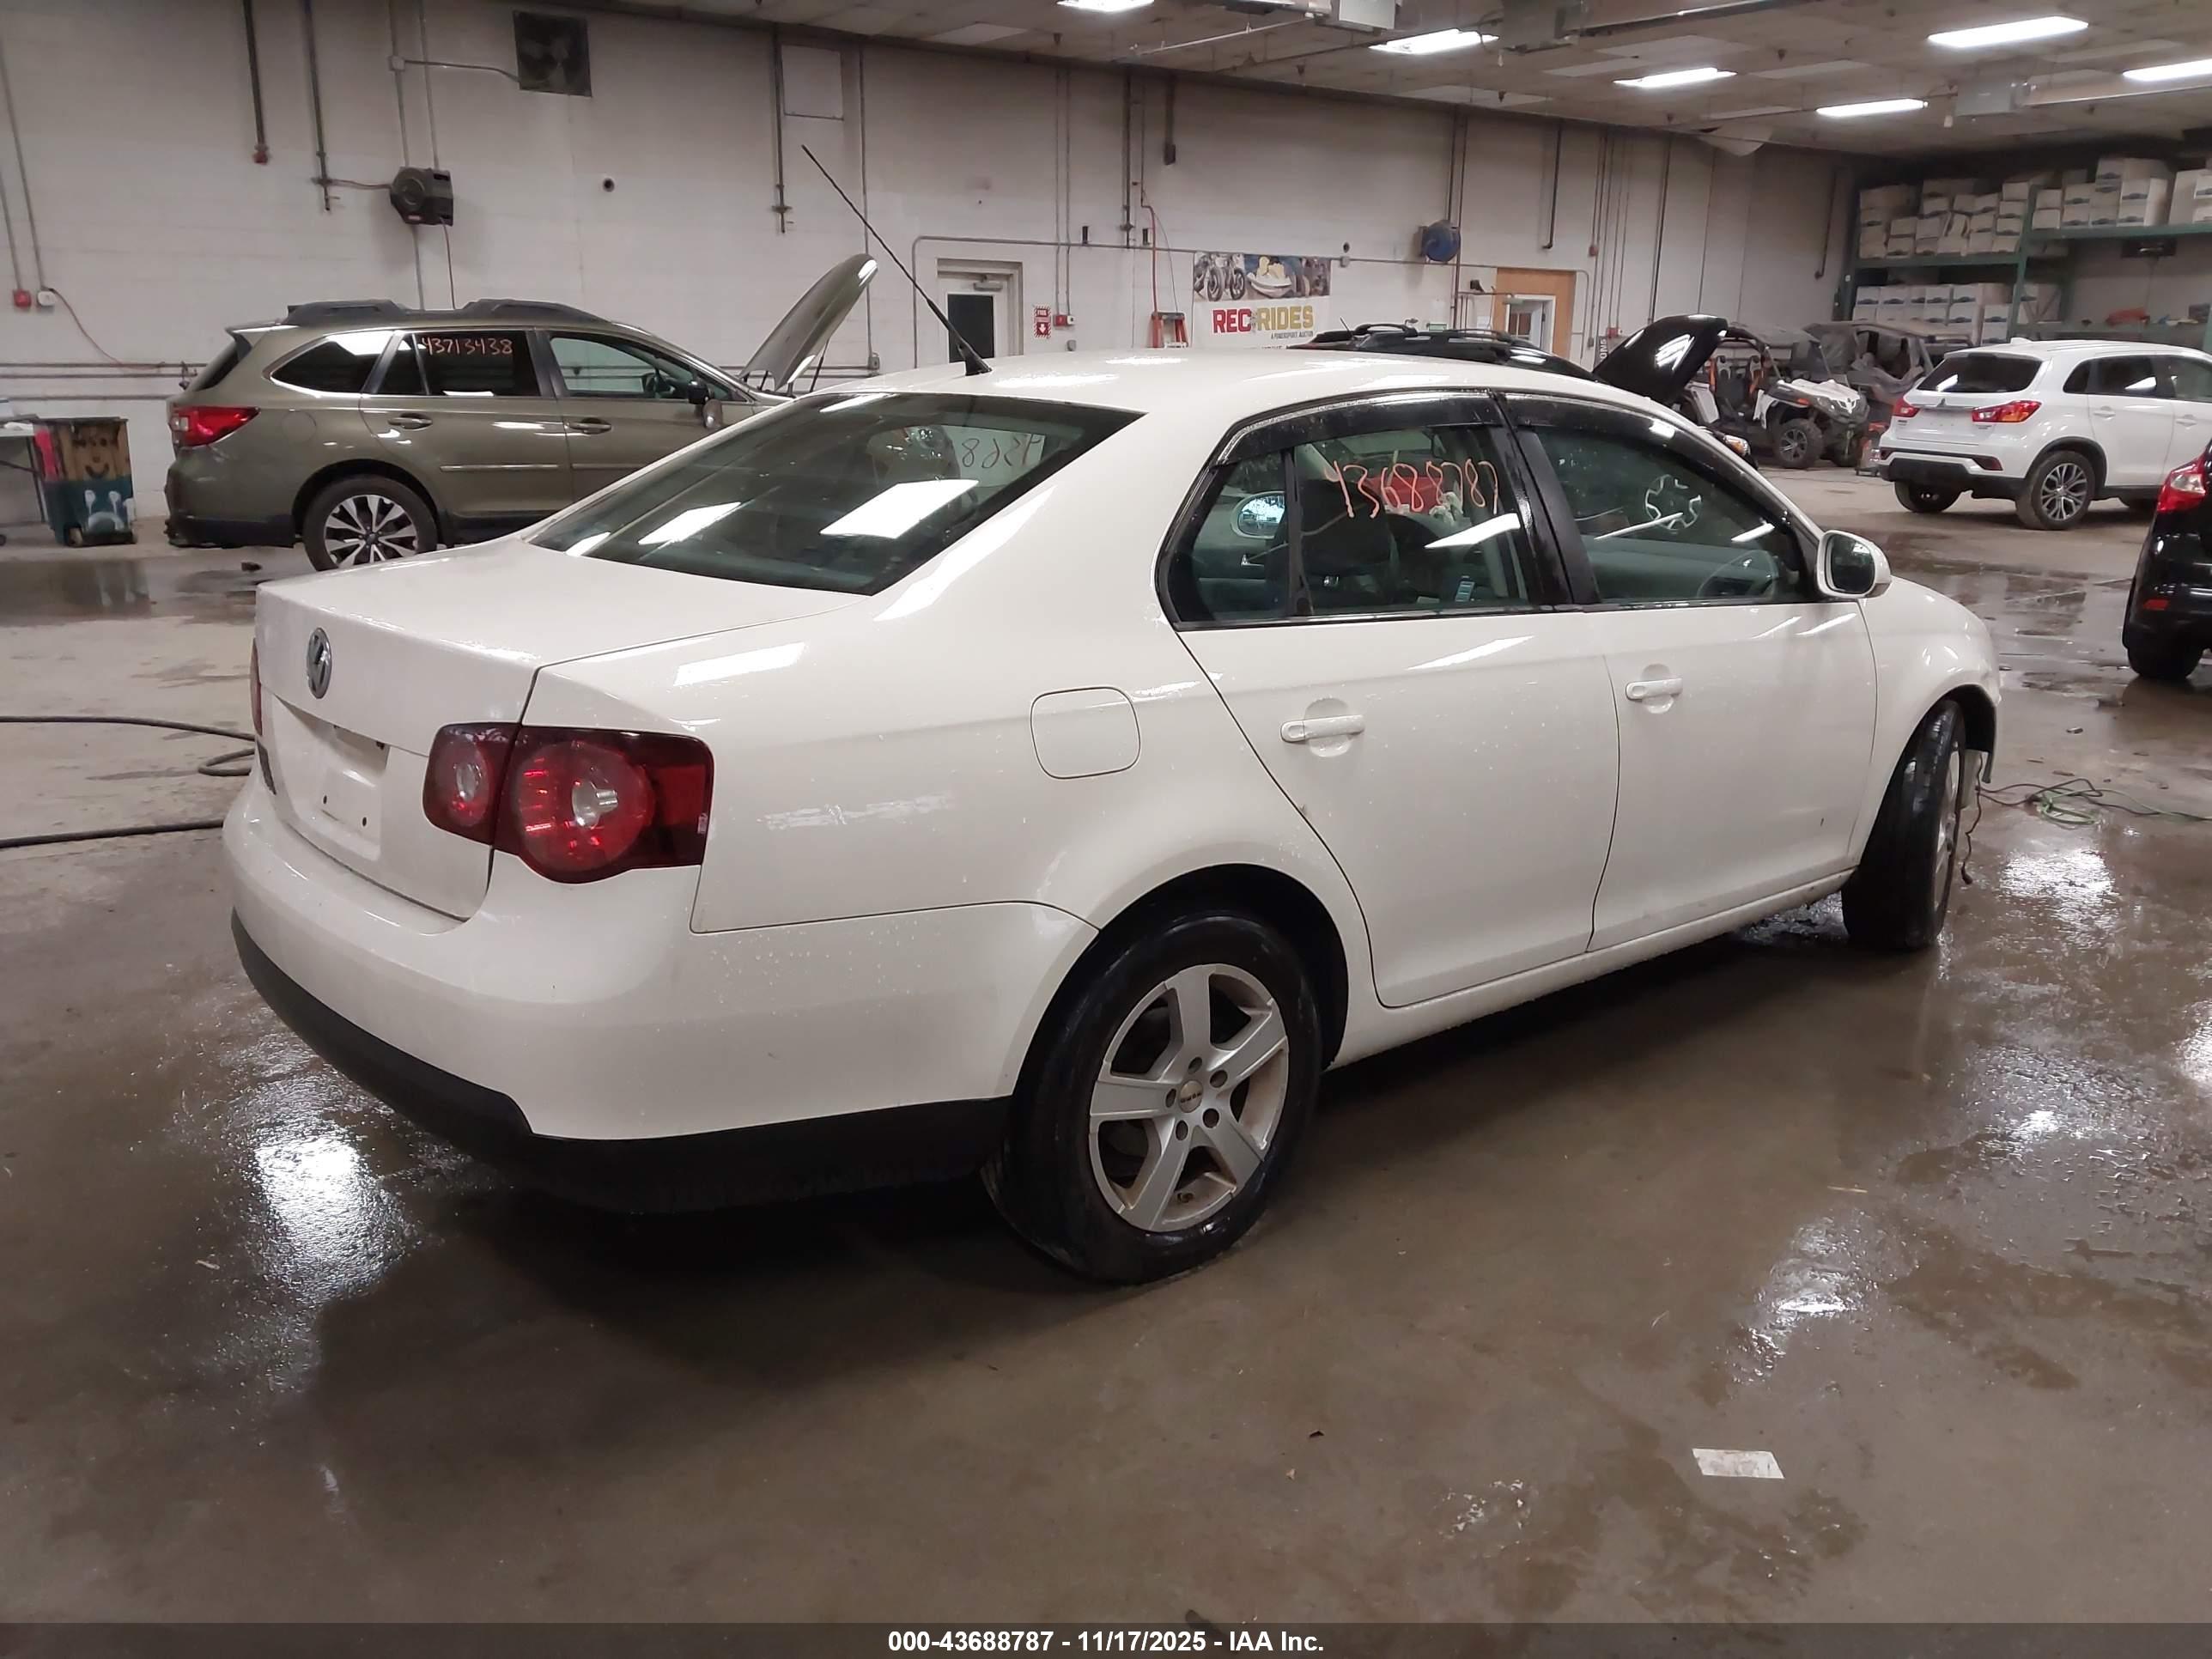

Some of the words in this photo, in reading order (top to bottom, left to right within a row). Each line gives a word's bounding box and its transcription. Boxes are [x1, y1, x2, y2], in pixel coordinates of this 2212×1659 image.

[1212, 308, 1251, 333] REC
[1256, 306, 1314, 331] RIDES
[422, 337, 513, 356] 43713438
[1324, 459, 1499, 519] 43688787
